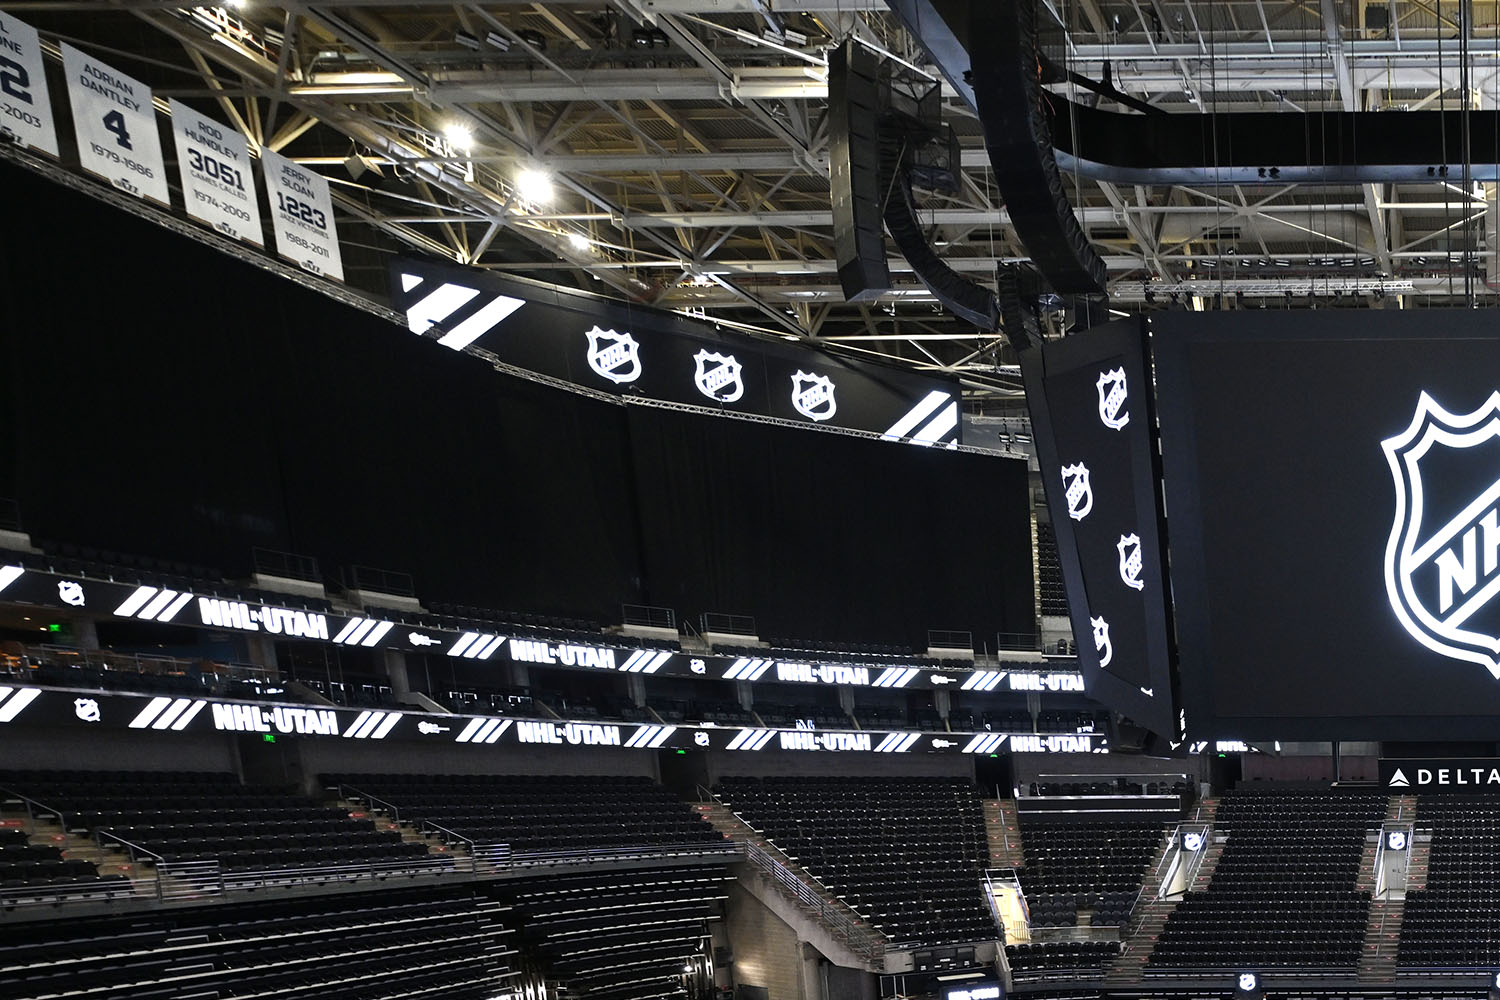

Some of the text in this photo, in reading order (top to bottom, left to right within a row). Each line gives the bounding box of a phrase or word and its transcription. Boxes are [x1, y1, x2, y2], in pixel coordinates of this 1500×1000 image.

[80, 75, 141, 113] DANTLEY
[84, 63, 133, 97] ADRIAN
[102, 109, 133, 151] 4
[184, 127, 239, 161] HUNDLEY
[198, 121, 222, 141] ROD
[187, 148, 245, 192] 3051
[281, 164, 311, 186] JERRY
[281, 176, 315, 201] SLOAN
[193, 188, 251, 222] 1974-2009
[277, 191, 327, 231] 1223
[284, 231, 330, 259] 1988-2011
[198, 597, 259, 631] NHL
[261, 606, 329, 640] UTAH
[509, 639, 556, 665] NHL
[559, 644, 615, 669] UTAH
[777, 663, 818, 683] NHL
[820, 665, 870, 685] UTAH
[1009, 673, 1045, 690] NHL
[212, 703, 271, 732] NHL
[273, 706, 339, 735] UTAH
[516, 721, 562, 744] NHL
[565, 723, 621, 746] UTAH
[780, 732, 820, 750] NHL
[823, 733, 872, 751] UTAH
[1010, 736, 1046, 753] NHL
[1048, 736, 1091, 753] UTAH
